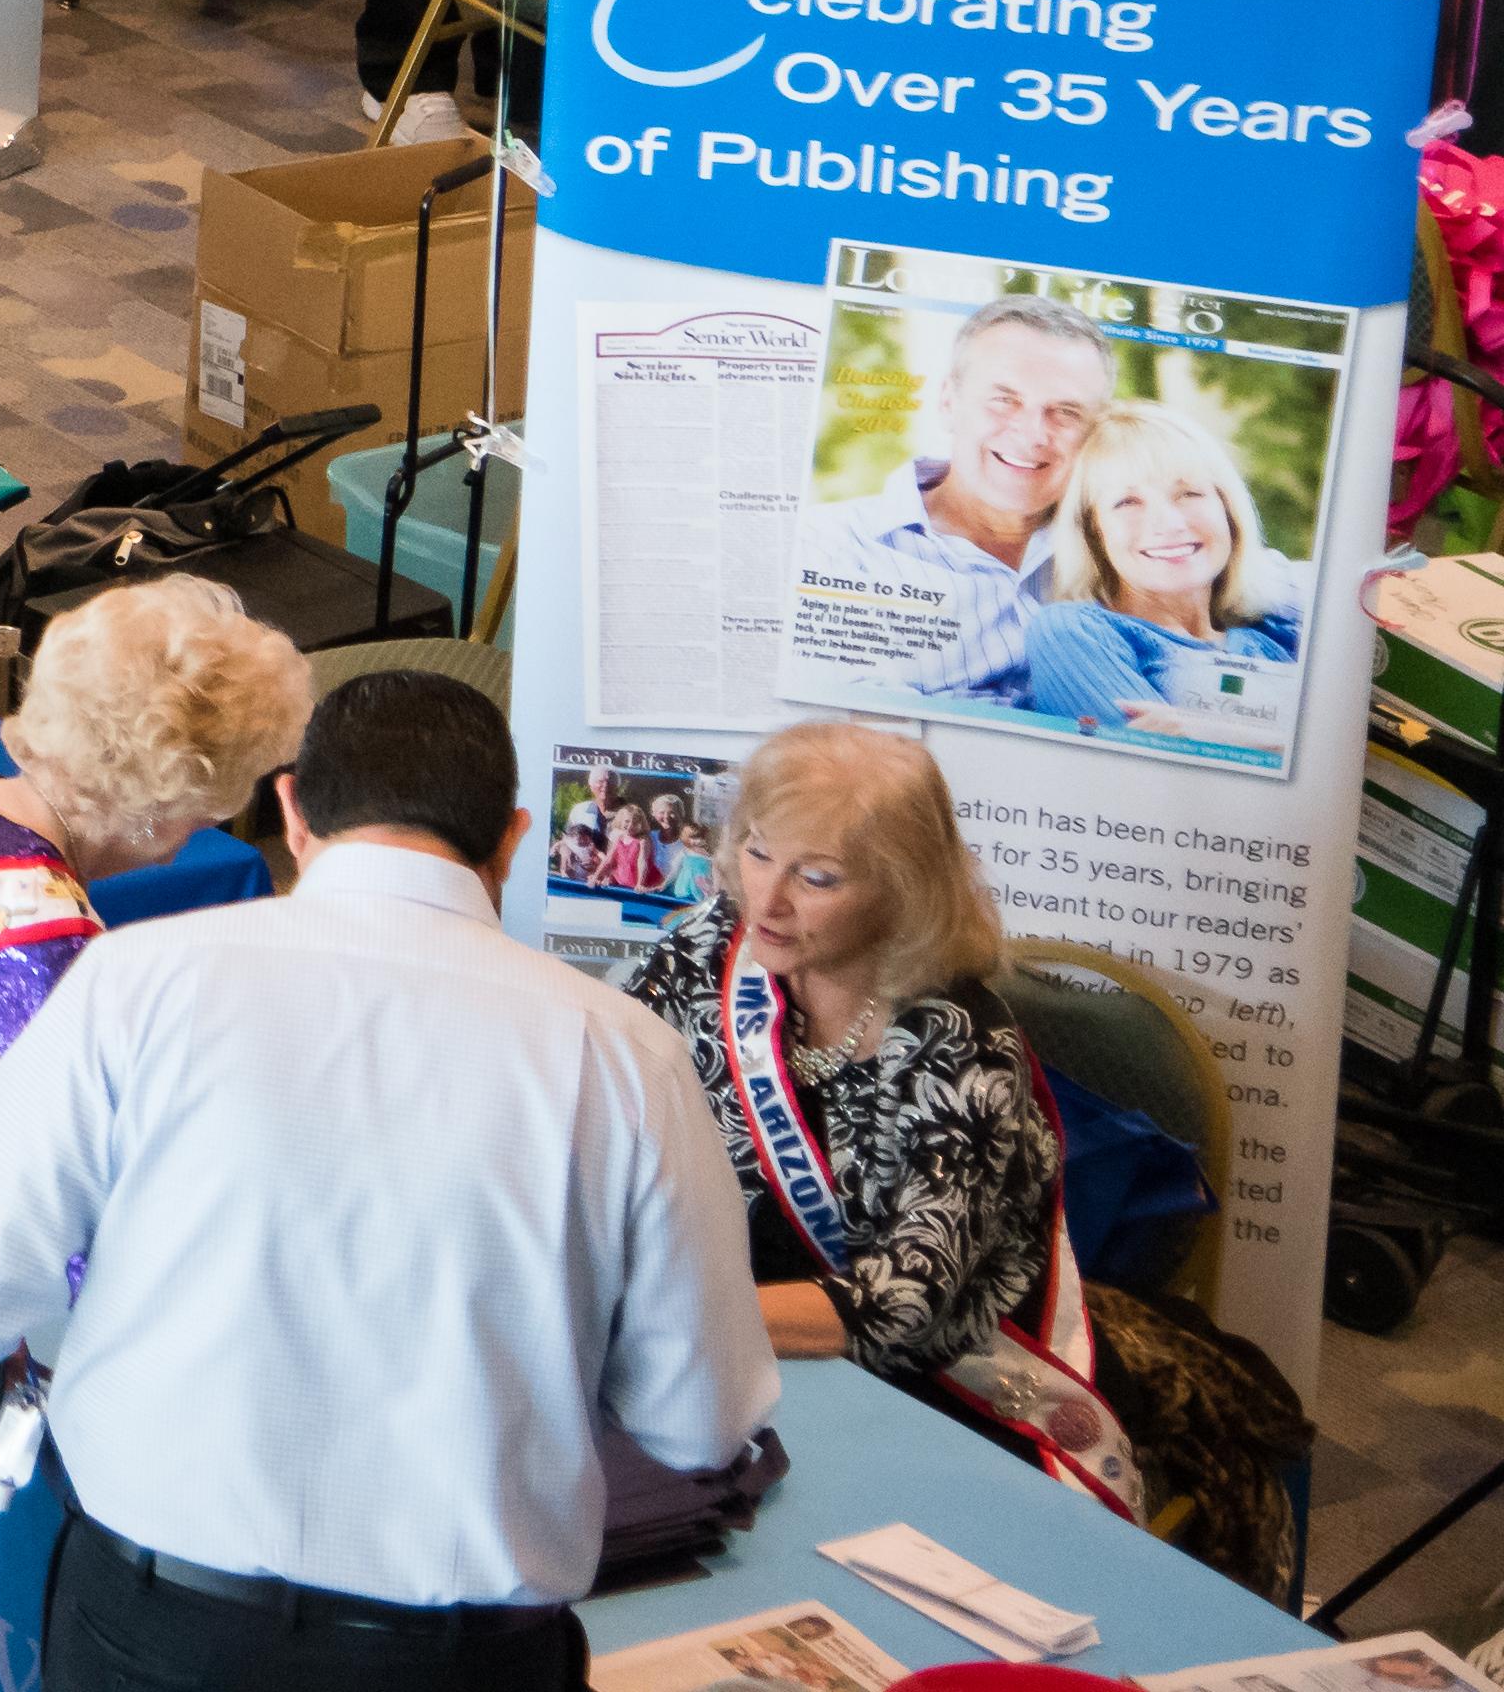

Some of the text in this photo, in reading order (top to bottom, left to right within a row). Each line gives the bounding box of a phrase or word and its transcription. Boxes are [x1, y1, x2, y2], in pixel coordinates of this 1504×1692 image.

[774, 52, 1374, 149] Over 35 Years
[584, 126, 1115, 224] of Publishing
[683, 327, 809, 349] Senior World
[1144, 329, 1219, 350] Since 1979
[626, 360, 683, 371] Senior
[717, 360, 794, 373] Property tax
[717, 372, 775, 383] advances
[778, 374, 803, 384] with
[835, 366, 928, 391] Housing
[837, 389, 922, 412] Choices
[719, 490, 782, 503] Challenge
[719, 502, 776, 513] cutbacks
[801, 569, 947, 607] Home to Stay
[796, 610, 958, 641] out of 10 boomers, requiring high
[832, 603, 842, 612] in
[876, 608, 884, 618] is
[886, 609, 902, 621] the
[904, 613, 927, 625] goal
[929, 615, 939, 626] of
[940, 618, 961, 629] nine
[793, 635, 917, 661] perfect in-home caregiver.
[795, 622, 817, 635] tech,
[821, 627, 849, 638] smart
[851, 628, 890, 646] building
[906, 638, 926, 650] and
[927, 639, 943, 652] the
[554, 746, 667, 771] Lovin' Life
[1037, 807, 1088, 836] has
[1095, 815, 1165, 846] been
[1174, 828, 1312, 868] changing
[992, 841, 1309, 910] for 35 years, bringing
[1098, 898, 1126, 923] to
[1131, 907, 1180, 929] our
[1186, 913, 1304, 946] readers'
[1172, 948, 1255, 980] 1979
[1267, 966, 1301, 987] as
[1227, 997, 1297, 1030] left),
[1266, 1045, 1295, 1068] to
[1238, 1137, 1287, 1163] the
[1234, 1219, 1280, 1245] the
